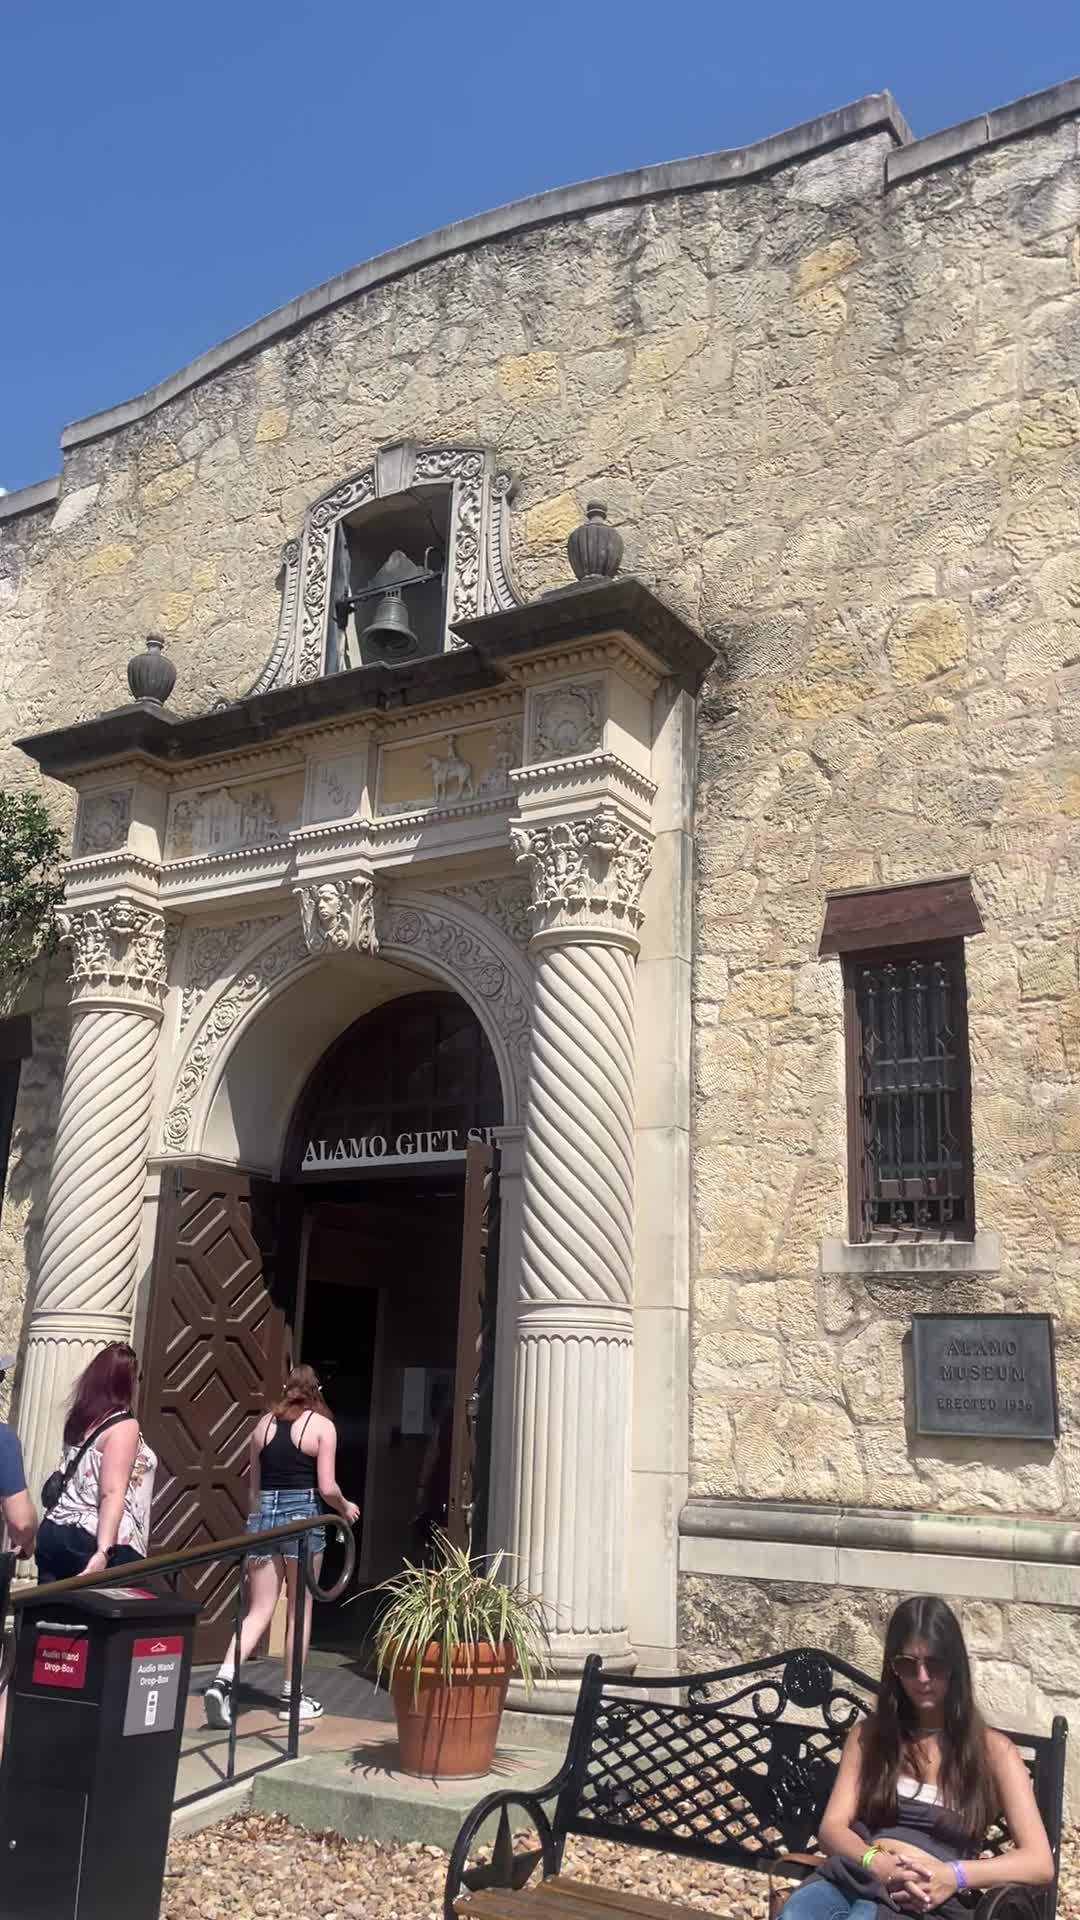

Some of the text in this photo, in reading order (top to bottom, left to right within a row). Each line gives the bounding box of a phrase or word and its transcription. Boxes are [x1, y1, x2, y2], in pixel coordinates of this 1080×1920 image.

[304, 1127, 502, 1161] ALAMO GIFT SH
[947, 1338, 1017, 1356] ALAMO
[941, 1365, 1025, 1382] MUSEUM
[937, 1398, 997, 1410] ERECTED
[42, 1649, 60, 1659] Audio
[44, 1662, 74, 1673] Drop-Box
[138, 1664, 156, 1673] Audio
[140, 1675, 169, 1686] Drop-Box
